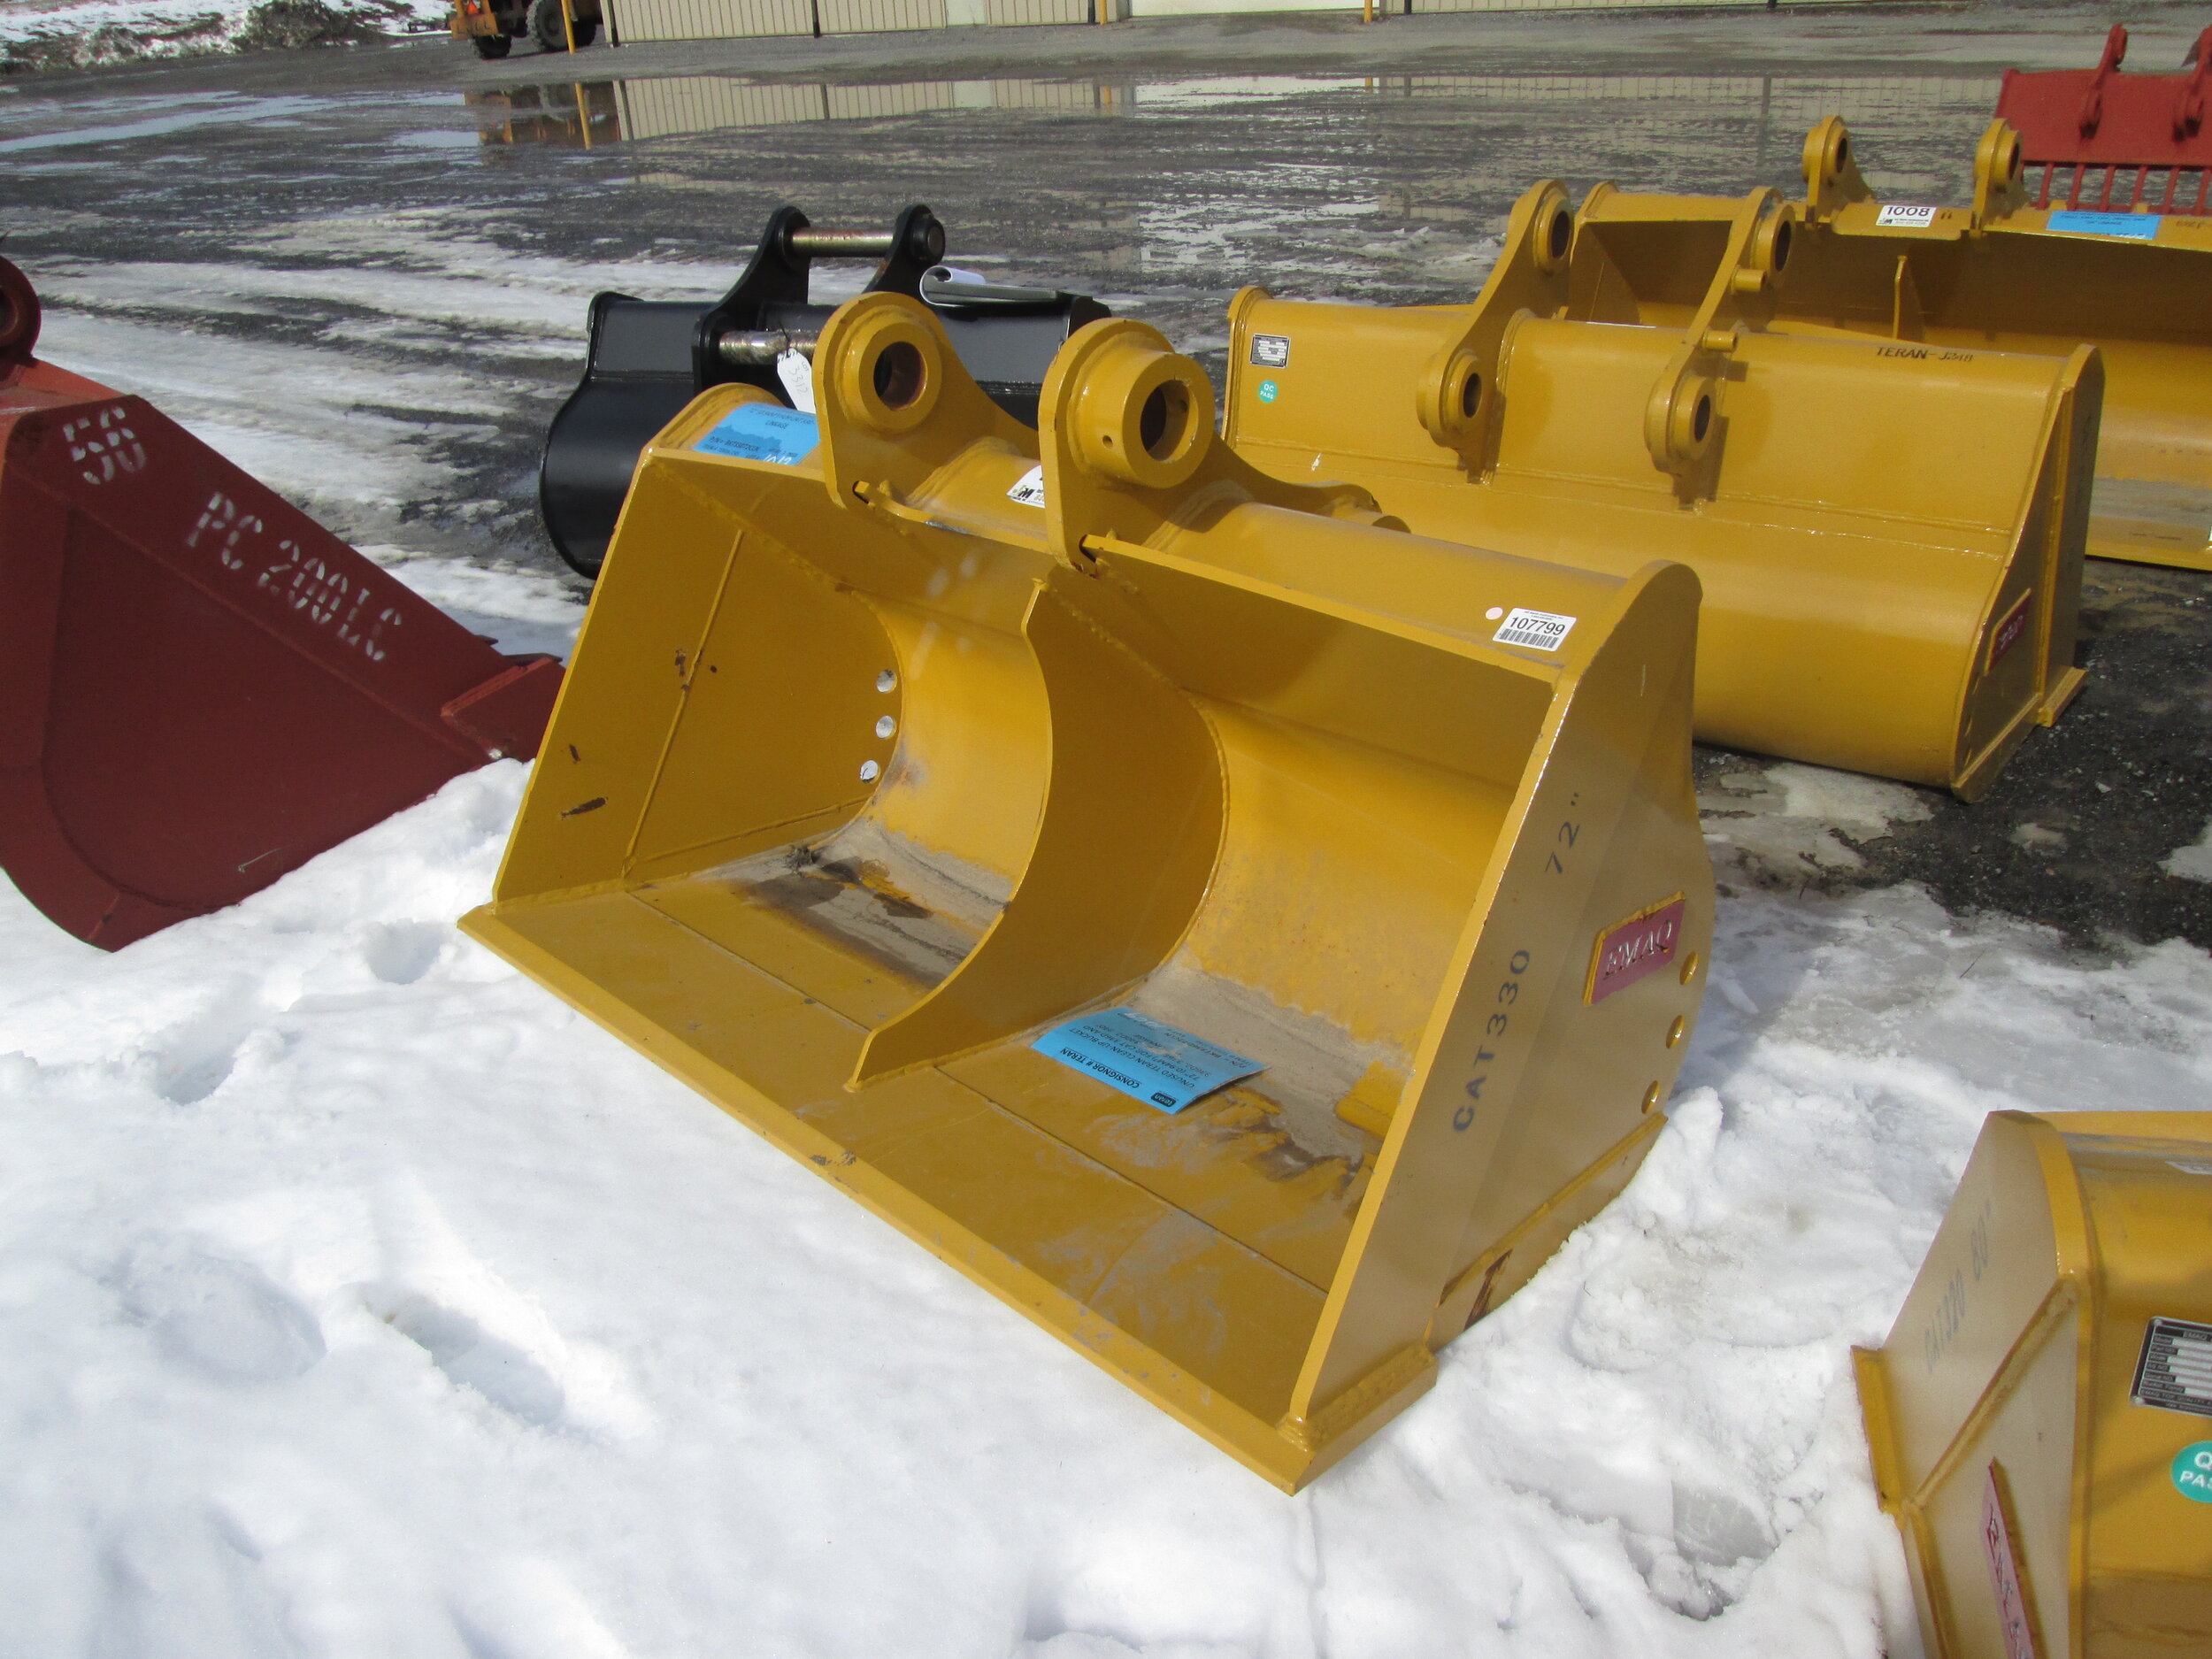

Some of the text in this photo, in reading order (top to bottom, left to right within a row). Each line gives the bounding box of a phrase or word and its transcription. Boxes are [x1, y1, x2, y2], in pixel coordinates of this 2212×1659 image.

[1886, 206, 1931, 217] 1008
[1259, 390, 1274, 400] PASS
[1263, 383, 1275, 393] QC
[186, 489, 265, 571] PC
[1509, 616, 1566, 636] 107799
[1452, 949, 1532, 1133] CAT330
[1059, 1048, 1085, 1064] TERAN
[1092, 1062, 1141, 1088] CONSIGNOR
[1161, 1069, 1195, 1088] UNUSED
